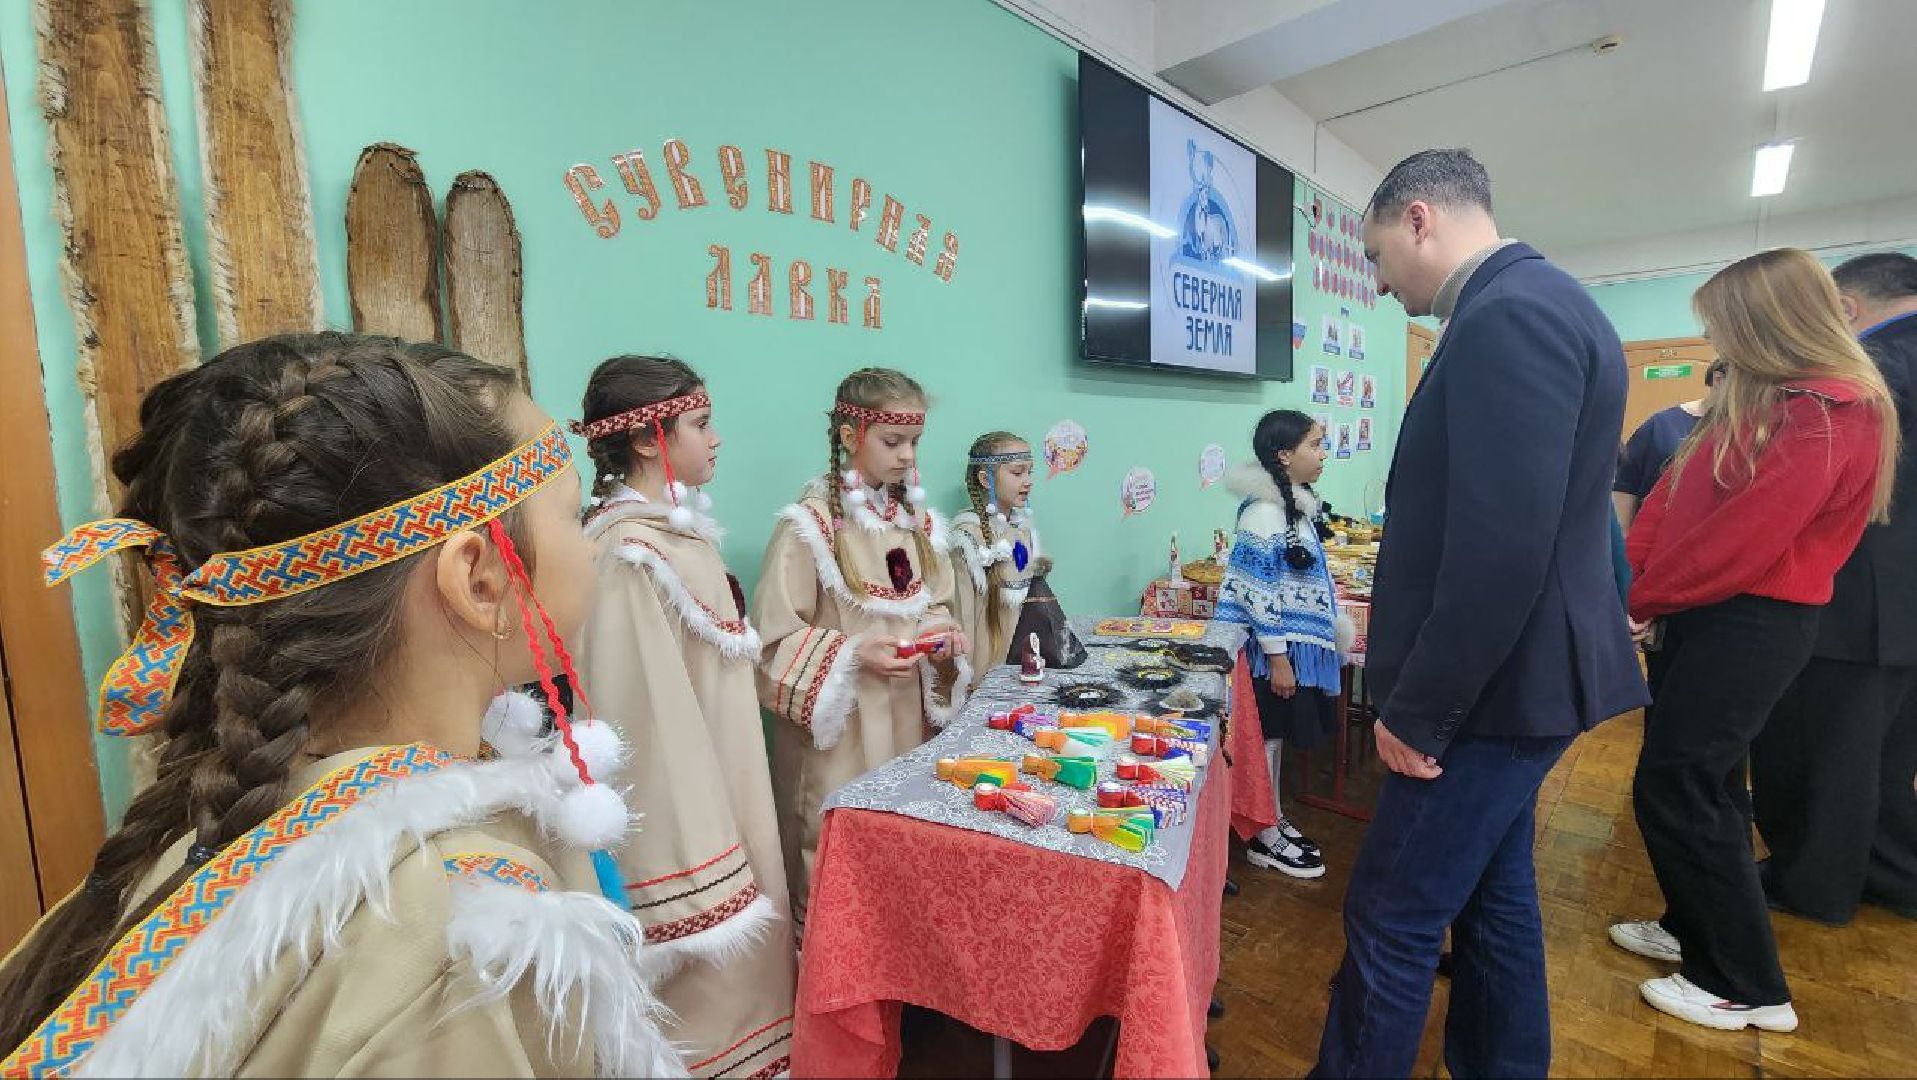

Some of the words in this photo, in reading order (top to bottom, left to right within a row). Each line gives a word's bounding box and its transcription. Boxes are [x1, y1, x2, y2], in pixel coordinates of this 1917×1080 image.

[564, 138, 958, 284] СУВЕНИРНАЯ
[706, 244, 883, 329] ЛАВКА
[1173, 272, 1242, 321] СЕВЕРНАЯ
[1185, 316, 1232, 356] ЗЕМЛЯ
